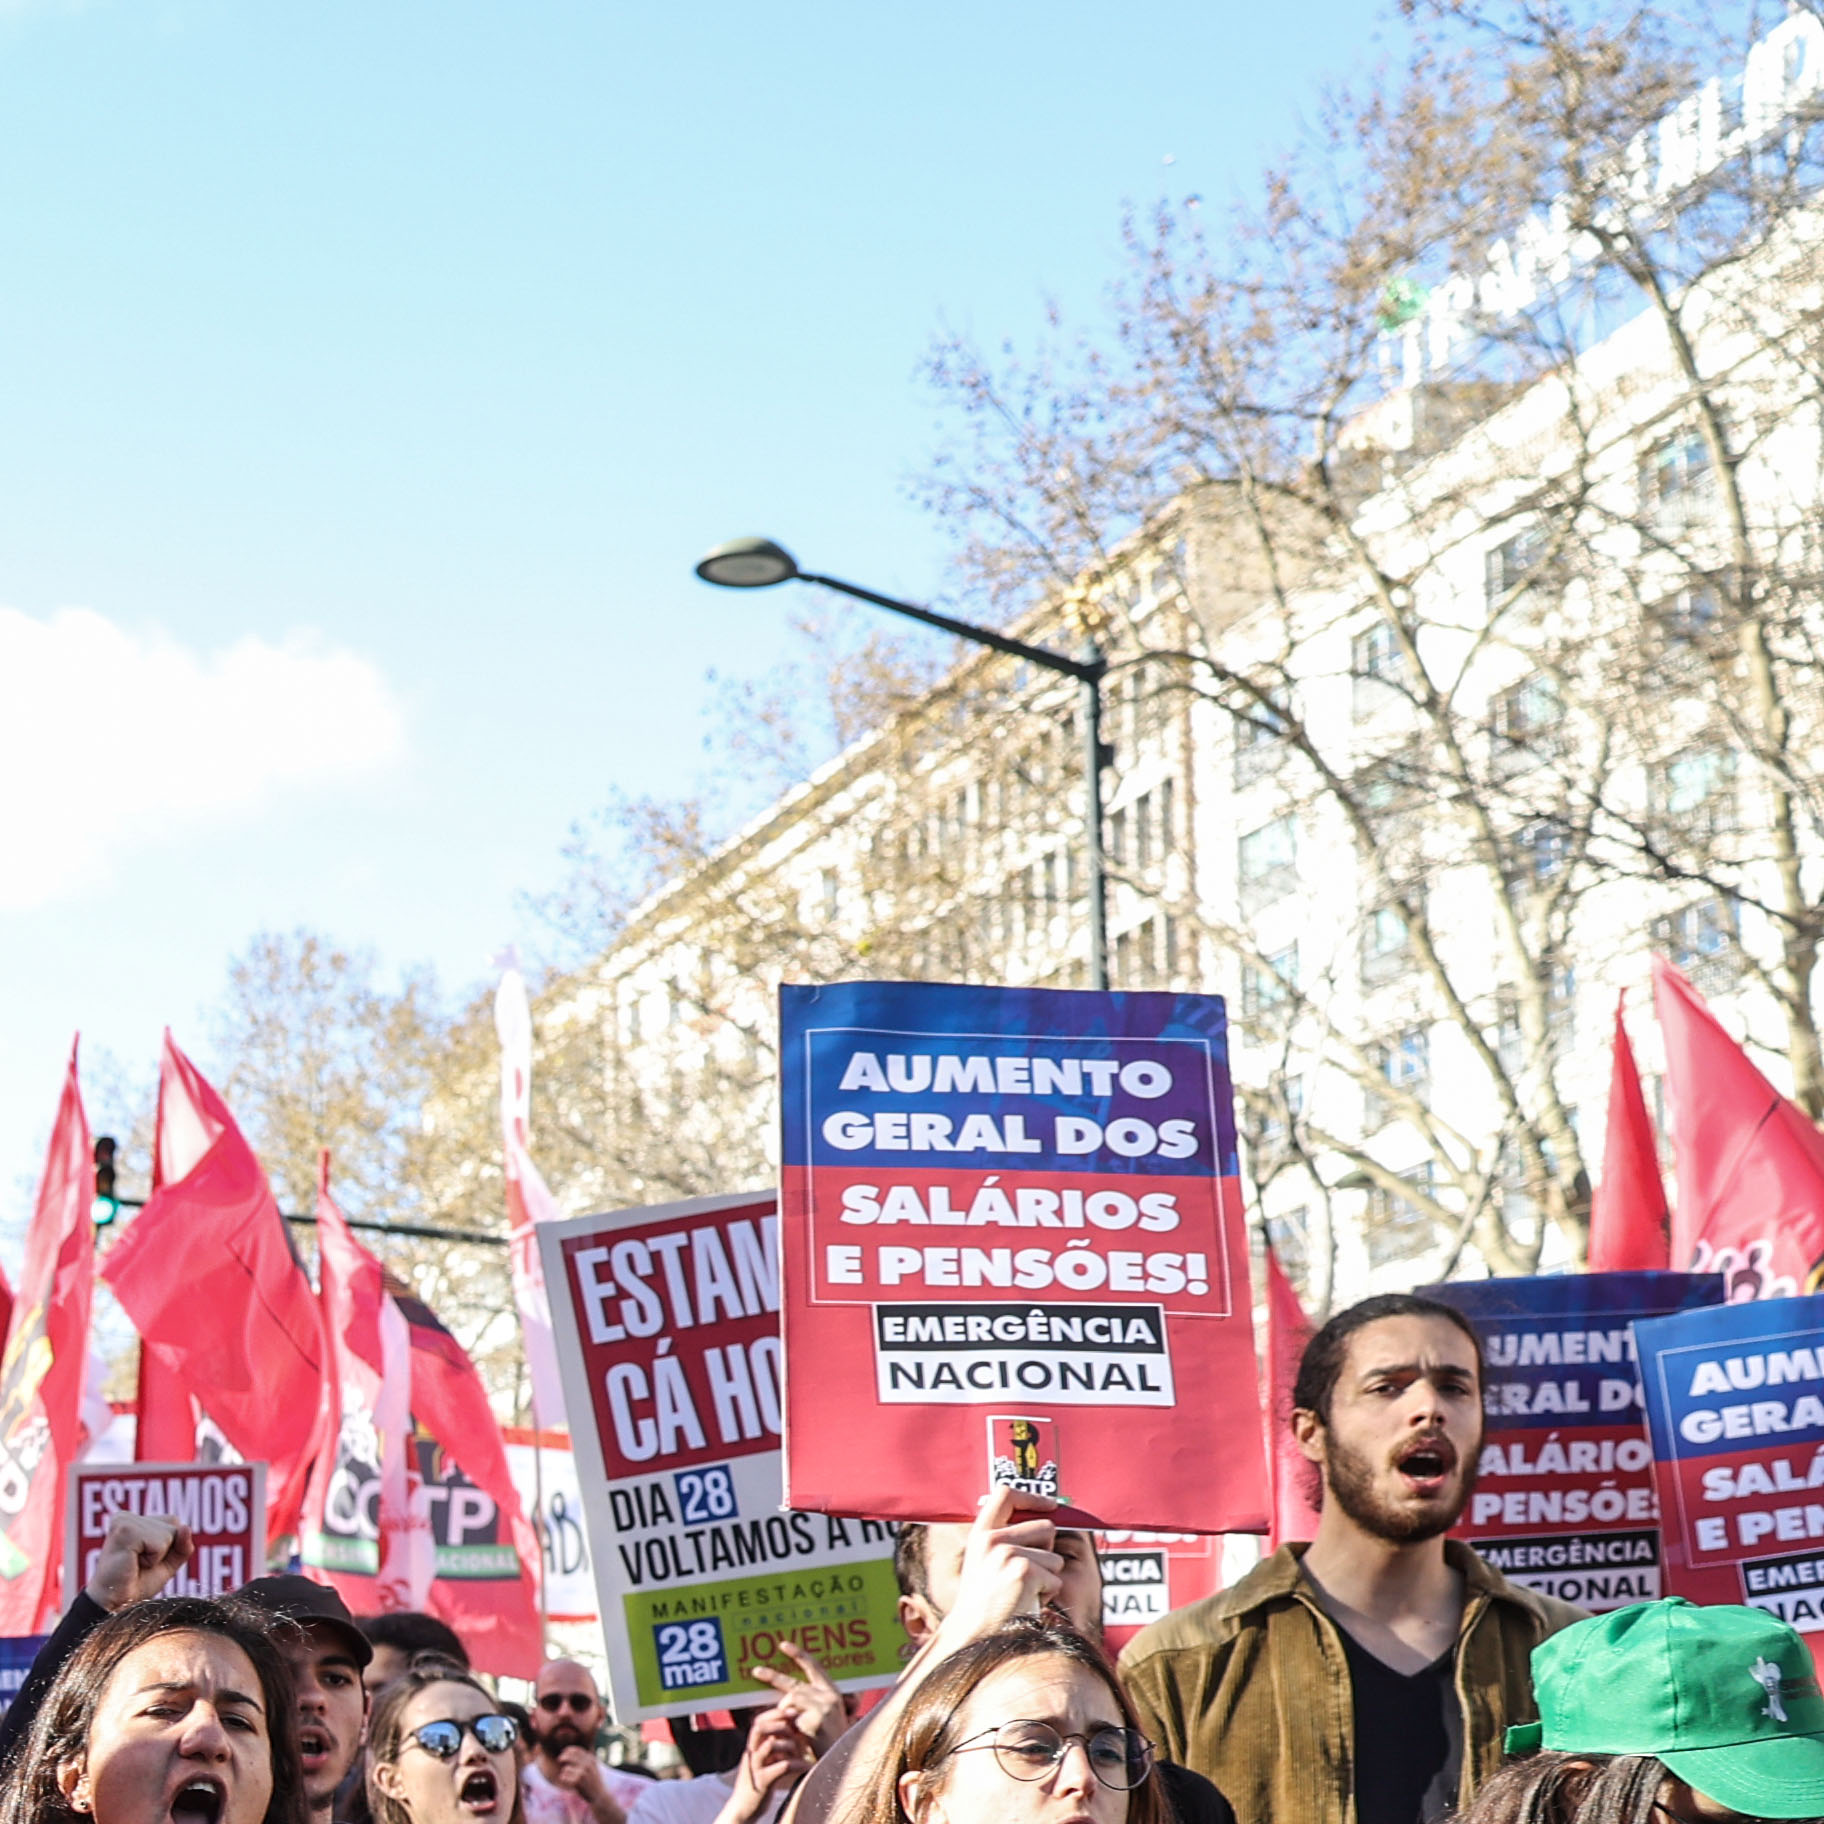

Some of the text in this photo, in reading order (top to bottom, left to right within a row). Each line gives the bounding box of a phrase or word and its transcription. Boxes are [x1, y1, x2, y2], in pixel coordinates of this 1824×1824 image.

[839, 1052, 1174, 1098] AUMENTO
[822, 1112, 1200, 1159] GERAL DOS
[840, 1176, 1181, 1232] SALÁRIOS
[827, 1239, 1209, 1297] E PENSÕES!
[882, 1308, 1156, 1346] EMERGÊNCIA
[889, 1359, 1163, 1393] NACIONAL
[605, 1336, 700, 1463] CÁ
[610, 1470, 735, 1533] DIA 28
[619, 1512, 816, 1586] VOLTAMOS
[1695, 1516, 1729, 1551] E
[653, 1574, 865, 1619] MANIFESTAÇÃO
[659, 1621, 720, 1663] 28
[737, 1619, 872, 1663] JOVENS
[664, 1660, 723, 1687] mar
